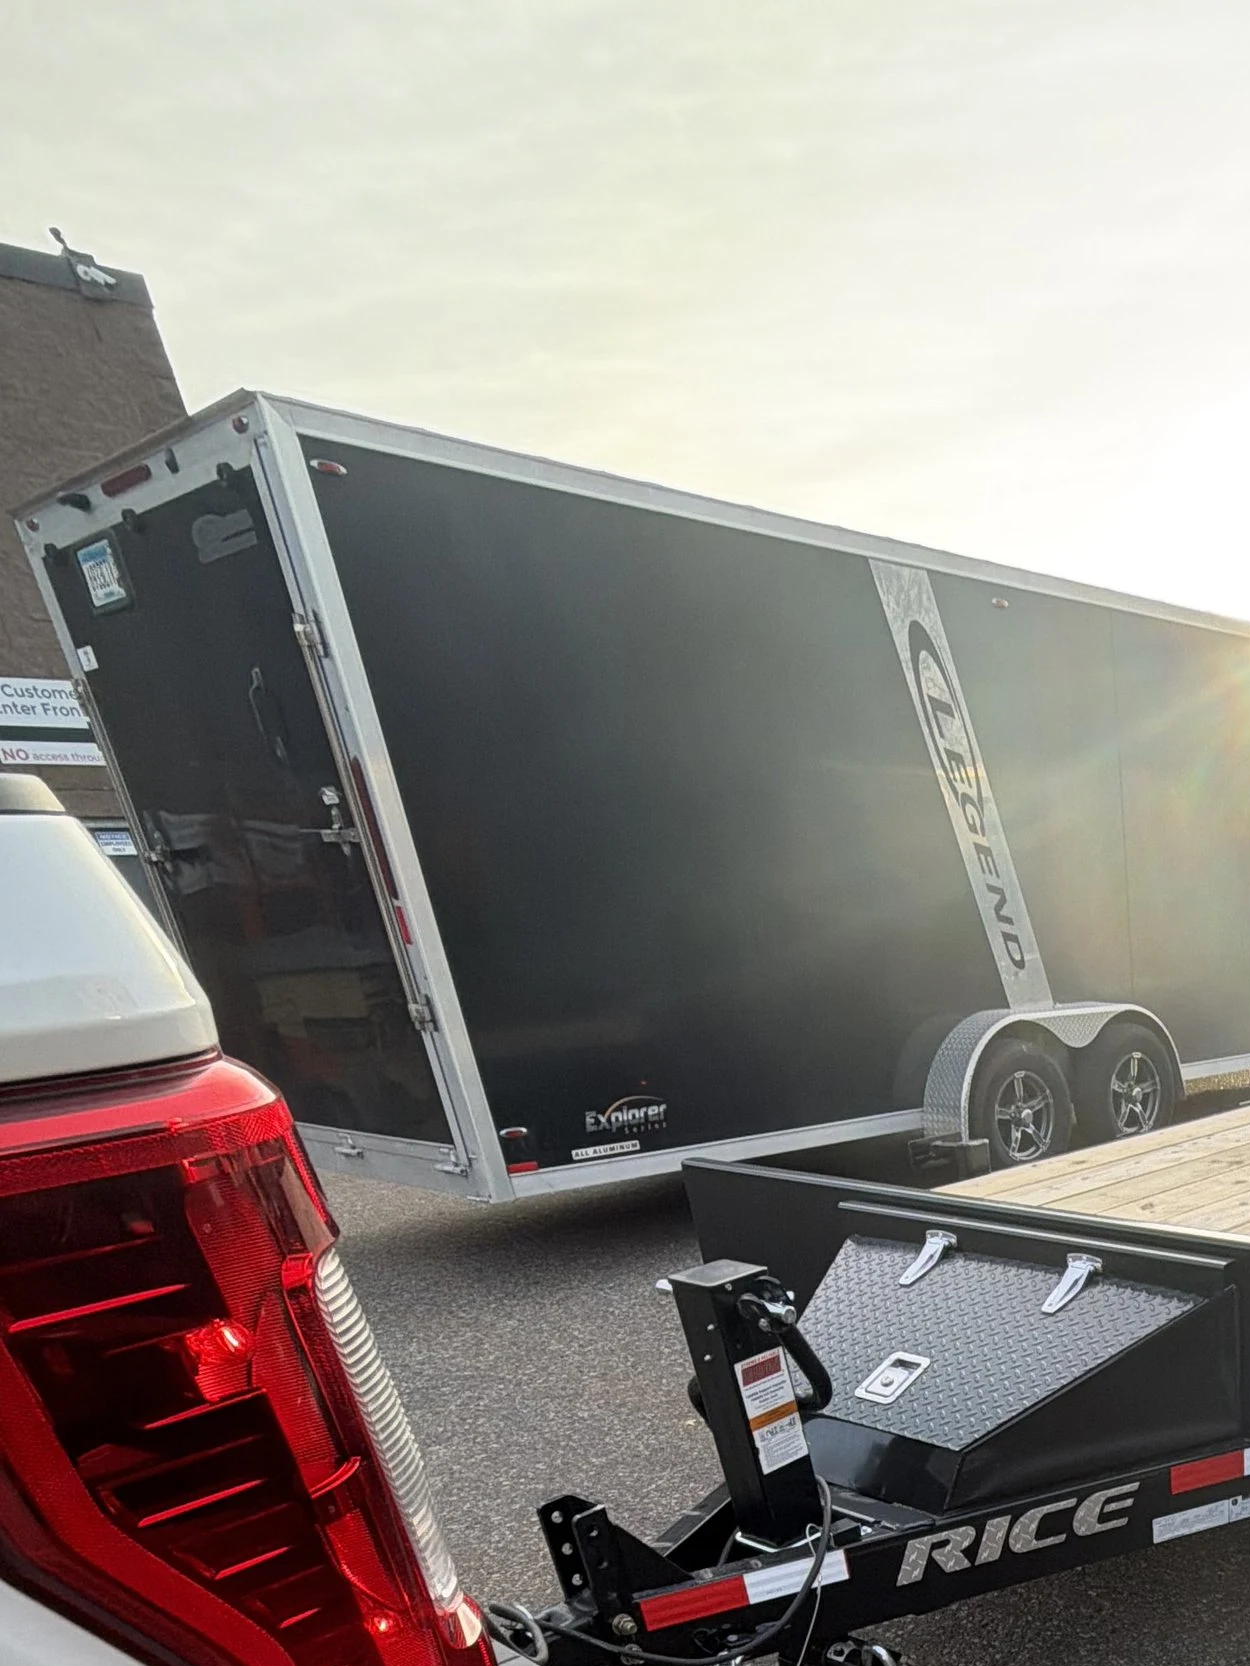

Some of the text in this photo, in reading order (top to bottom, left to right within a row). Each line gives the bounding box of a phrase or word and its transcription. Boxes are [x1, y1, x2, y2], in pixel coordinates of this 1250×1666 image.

[1, 748, 29, 761] NO
[927, 692, 1026, 971] LEGEND
[585, 1103, 667, 1133] Explorer
[574, 1142, 638, 1158] ALL ALUMINUM
[896, 1481, 1140, 1587] RICE
